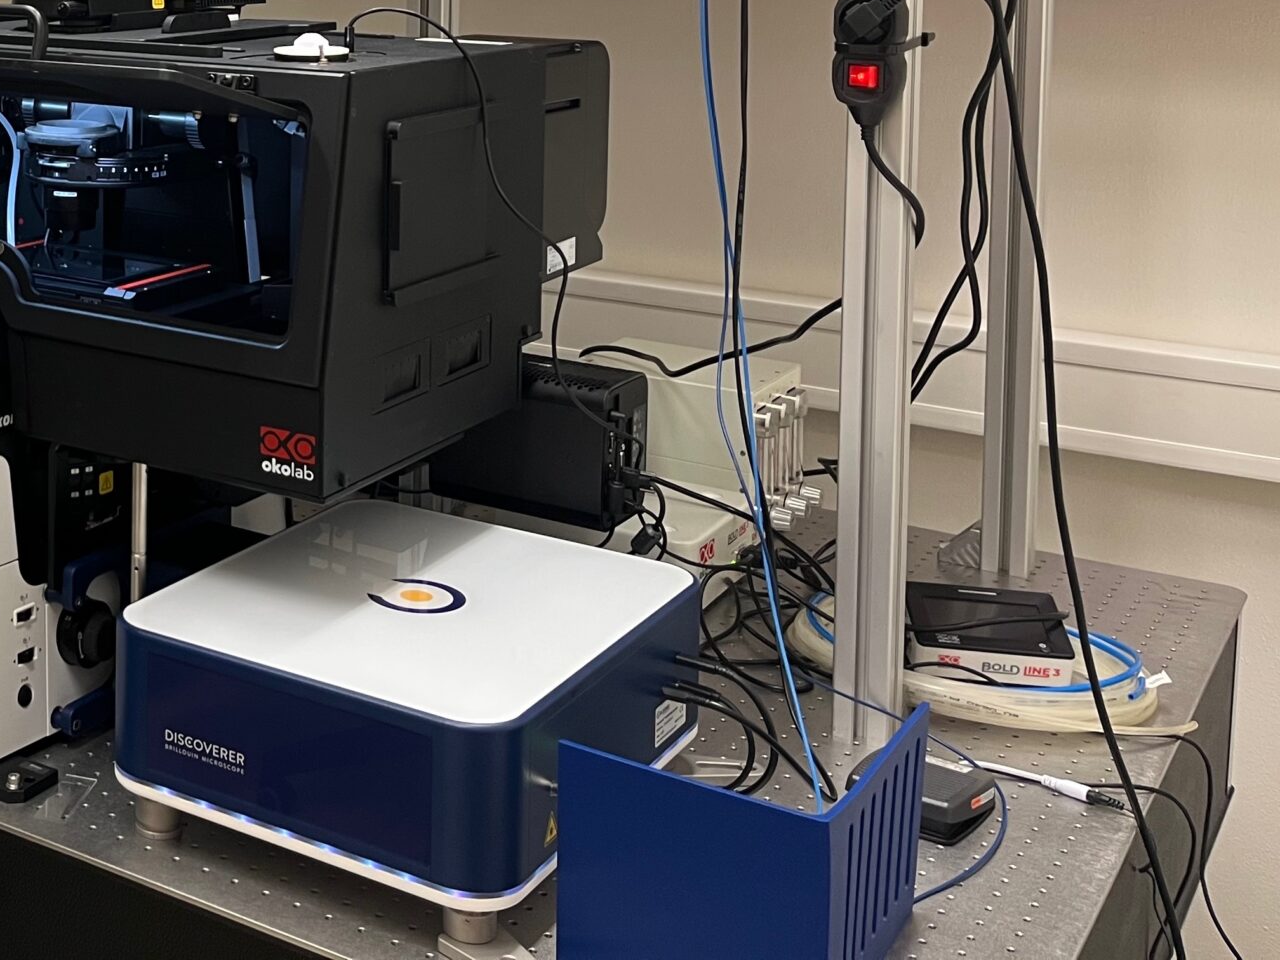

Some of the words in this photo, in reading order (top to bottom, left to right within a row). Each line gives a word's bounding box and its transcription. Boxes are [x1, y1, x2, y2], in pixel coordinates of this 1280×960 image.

[261, 457, 314, 481] okolab
[981, 661, 1020, 676] BOLD
[1023, 666, 1050, 678] LINE
[1052, 668, 1061, 677] 3
[164, 728, 245, 766] DISCOVERER
[164, 743, 199, 760] BRILLOUIN
[201, 756, 245, 775] MICROSCOPE
